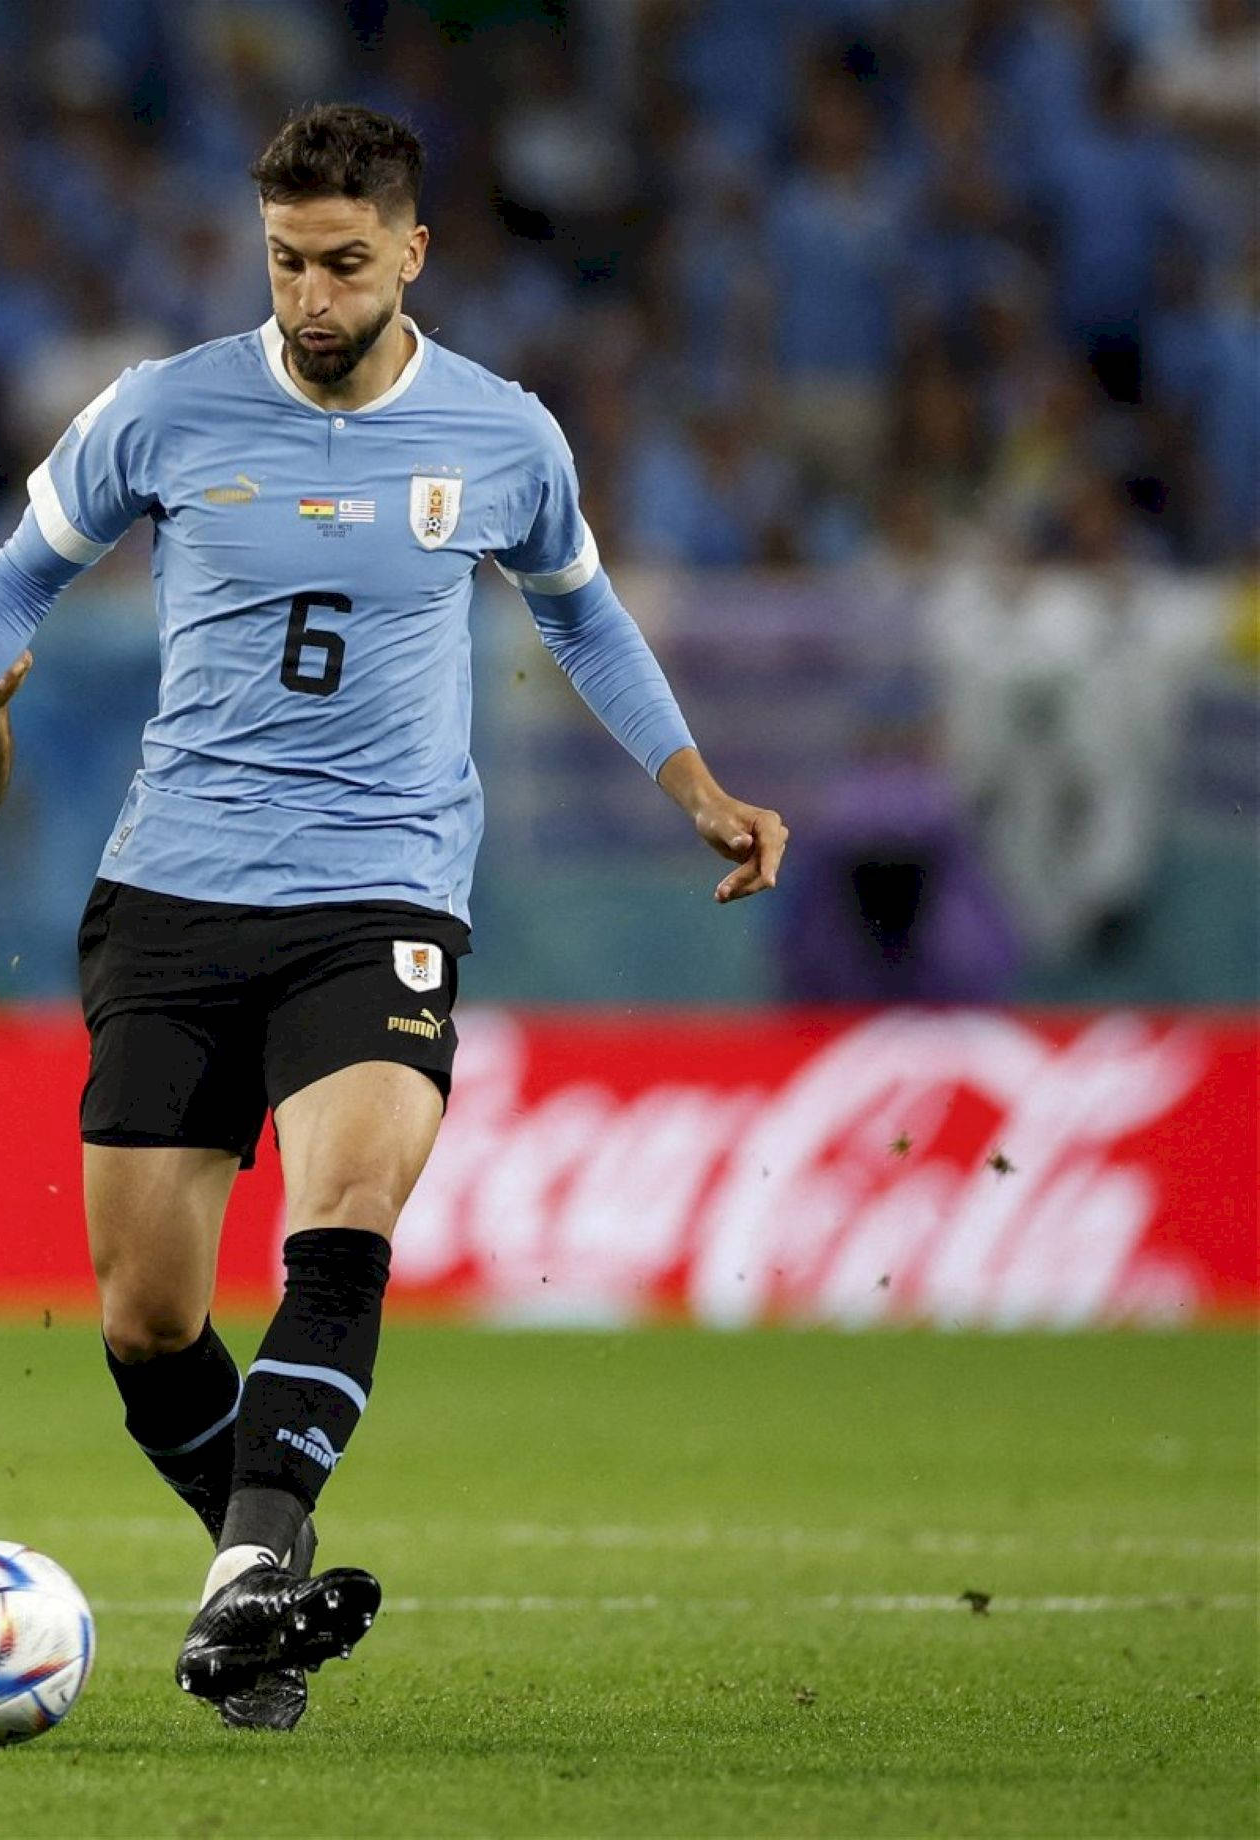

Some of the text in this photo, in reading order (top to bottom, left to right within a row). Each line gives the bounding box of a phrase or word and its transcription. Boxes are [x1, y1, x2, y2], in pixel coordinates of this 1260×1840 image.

[280, 591, 353, 697] 6
[387, 1016, 436, 1040] PUMA
[275, 1428, 332, 1471] PUMA
